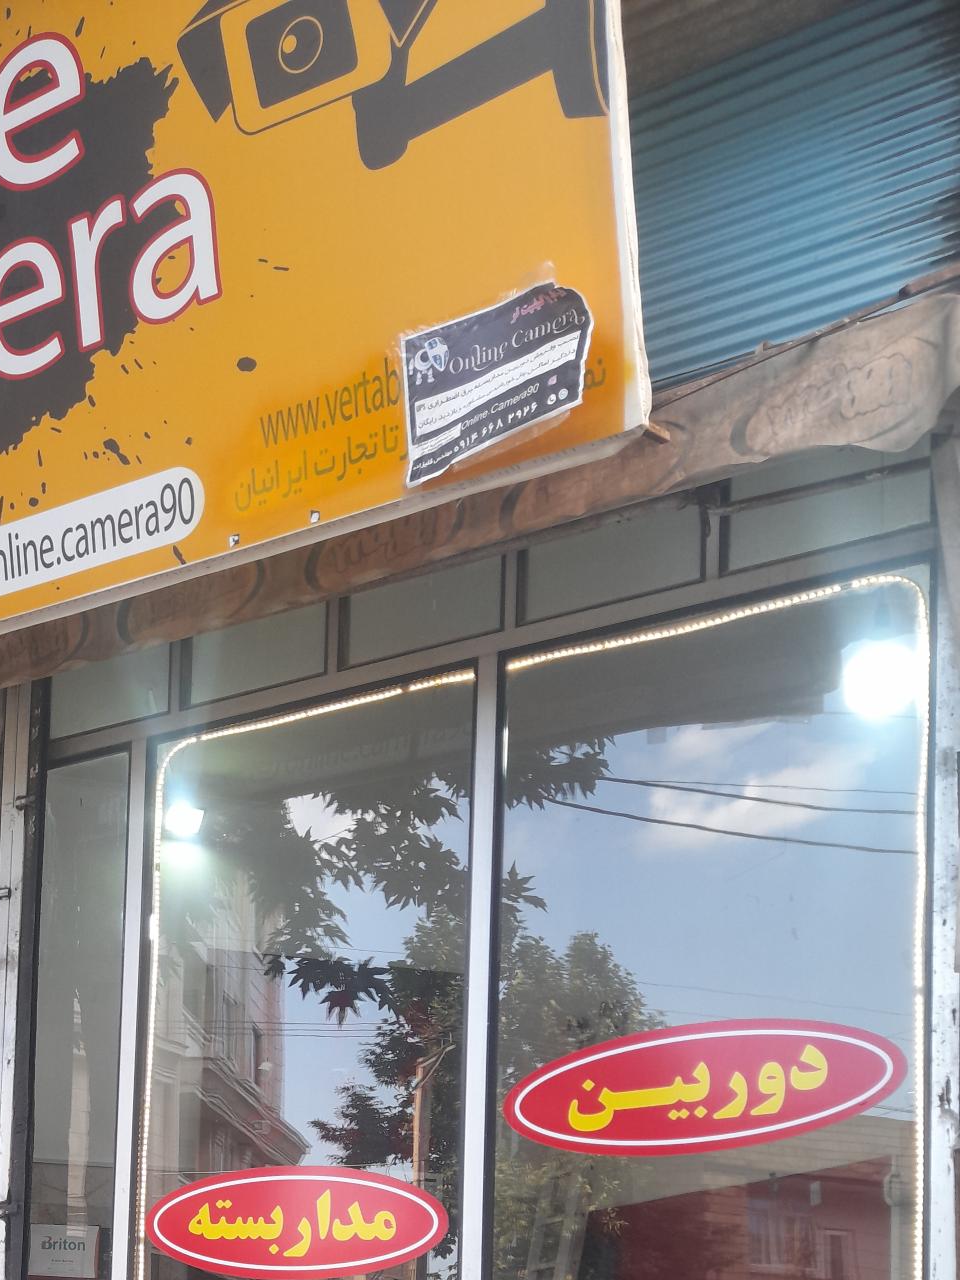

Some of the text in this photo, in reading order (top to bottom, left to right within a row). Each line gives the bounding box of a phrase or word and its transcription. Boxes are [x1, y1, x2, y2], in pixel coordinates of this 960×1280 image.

[449, 308, 586, 374] Online Camera
[259, 357, 401, 448] www.vertab
[314, 432, 378, 481] تجارت
[568, 1042, 828, 1133] دوربین
[41, 1236, 85, 1251] Briton
